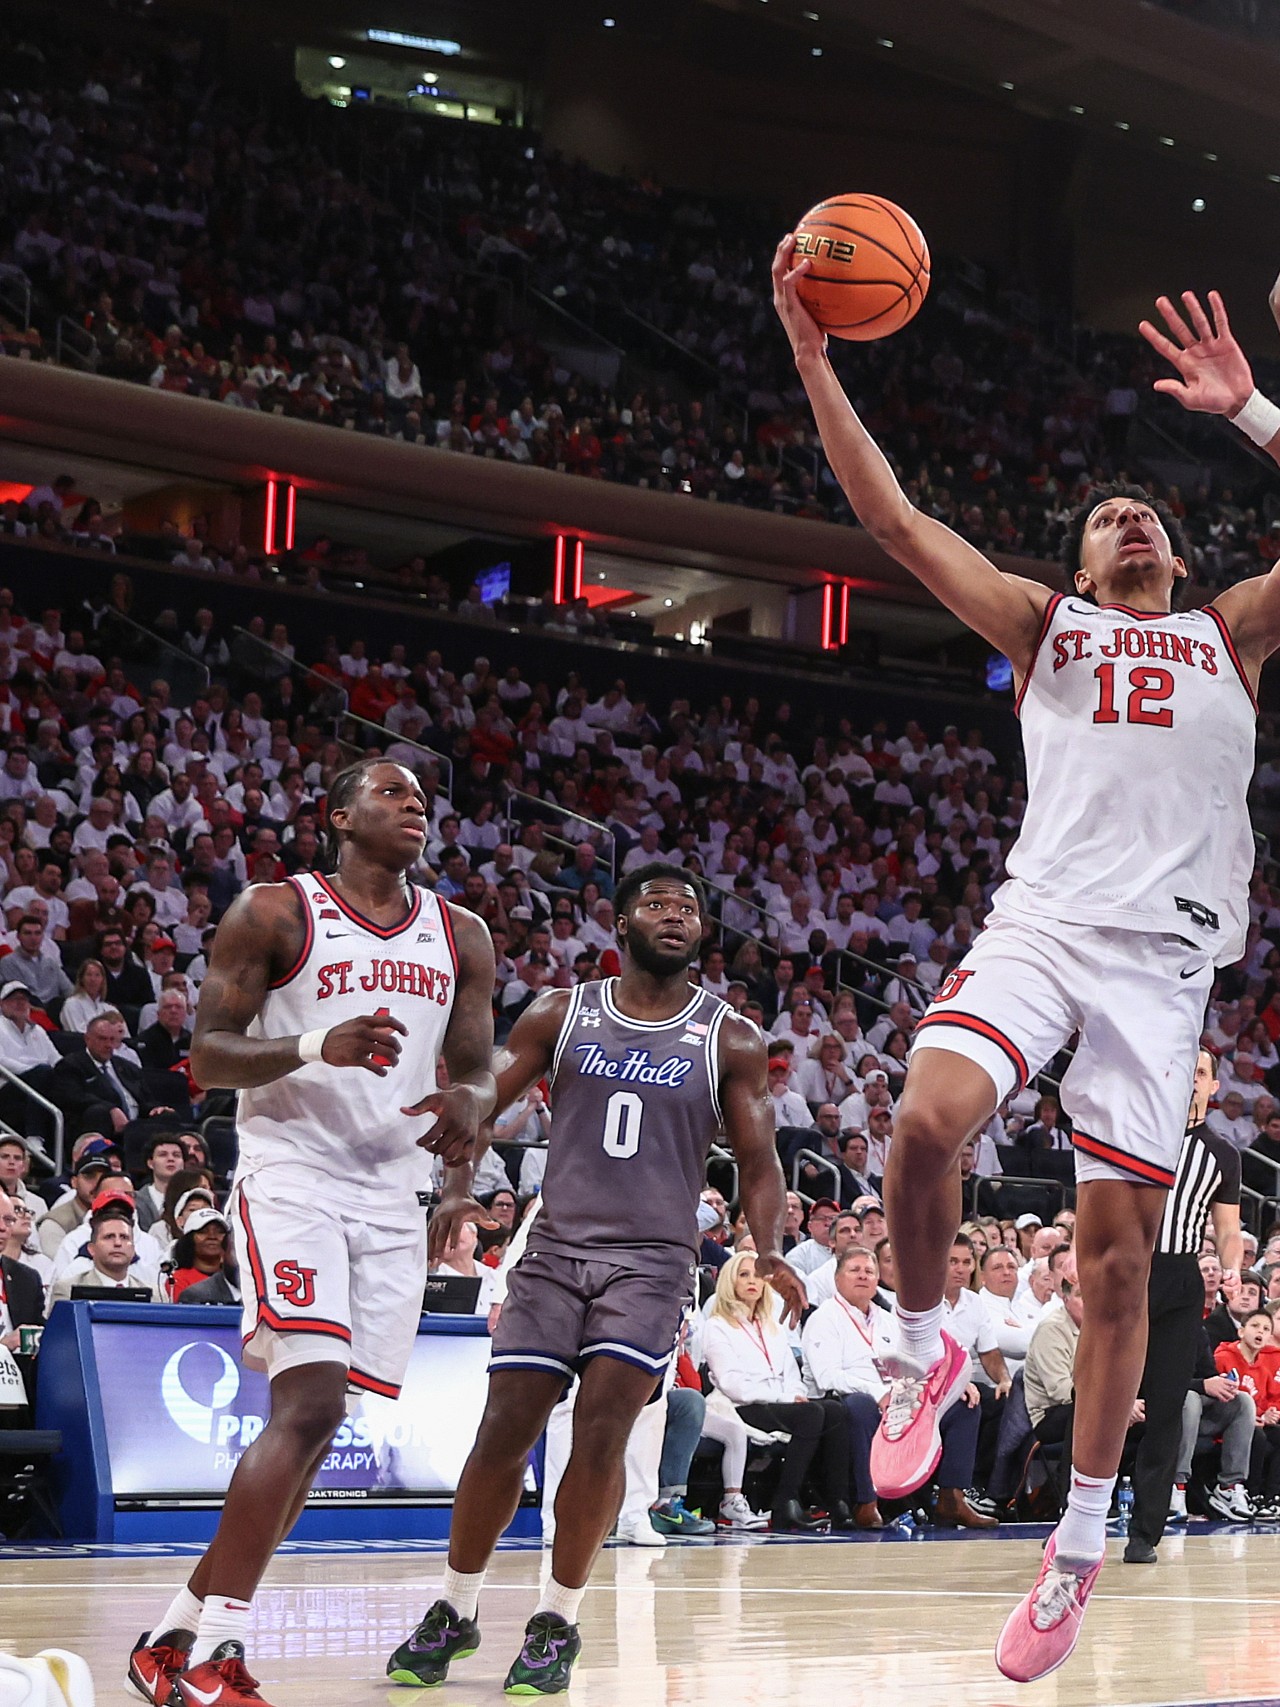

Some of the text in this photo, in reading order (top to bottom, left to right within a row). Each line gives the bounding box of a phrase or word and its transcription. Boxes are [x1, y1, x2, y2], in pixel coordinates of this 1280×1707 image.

[1053, 627, 1218, 676] ST. JOHN'S
[1093, 663, 1174, 728] 12
[317, 959, 451, 1006] ST. JOHN'S
[575, 1044, 692, 1087] The Hall
[602, 1090, 644, 1160] 0
[273, 1259, 318, 1307] SJ
[320, 1452, 375, 1470] ERAPY
